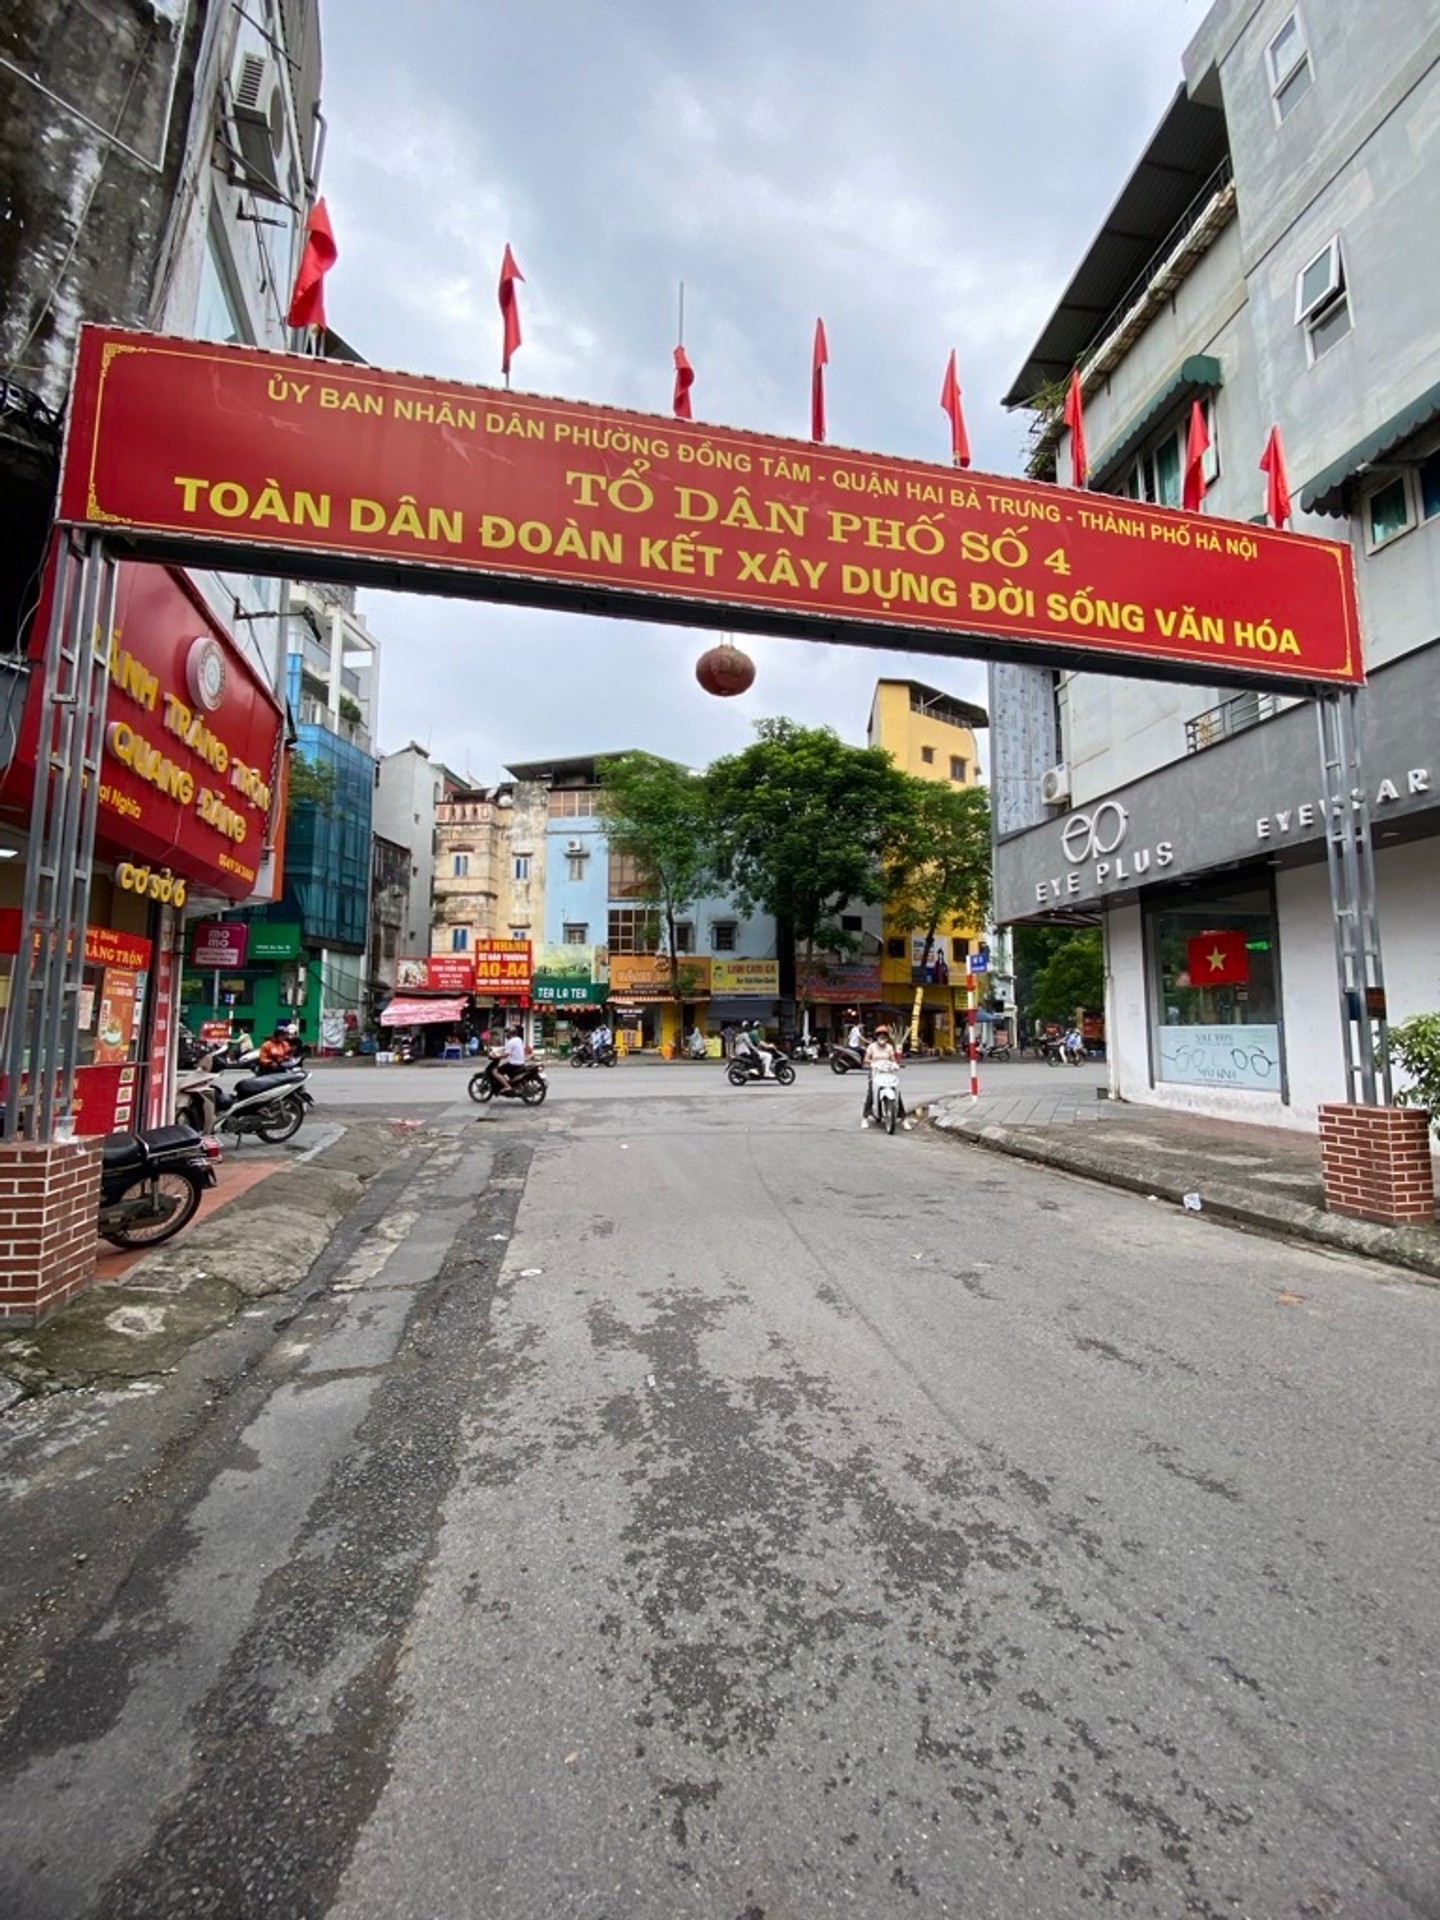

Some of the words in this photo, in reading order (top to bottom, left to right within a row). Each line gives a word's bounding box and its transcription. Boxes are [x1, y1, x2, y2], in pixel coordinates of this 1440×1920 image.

[268, 373, 310, 404] ỦY
[320, 388, 383, 416] BAN
[394, 400, 476, 431] NHÂN
[486, 412, 544, 440] DÂN
[554, 423, 670, 460] PHƯỜNG
[677, 440, 752, 474] ĐỒNG
[759, 456, 811, 483] TÂM
[832, 470, 899, 502] QUẬN
[906, 481, 945, 505] HAI
[950, 486, 981, 510] BÀ
[986, 496, 1061, 524] TRƯNG
[1079, 510, 1145, 541] THÀNH
[1150, 520, 1191, 548] PHỐ
[1196, 532, 1222, 555] HÀ
[1226, 537, 1258, 561] NỘI
[566, 458, 653, 513] TỔ
[674, 485, 809, 538] DÂN
[827, 511, 945, 557] PHỐ
[961, 526, 1029, 569] SỐ
[1043, 548, 1071, 576] 4
[174, 476, 331, 529] TOÀN
[350, 494, 463, 544] DÂN
[479, 515, 623, 566] ĐOÀN
[639, 530, 723, 577] KẾT
[737, 548, 828, 591] XÂY
[842, 564, 958, 610] DỰNG
[968, 577, 1034, 619] ĐỜI
[1046, 586, 1146, 635] SỐNG
[1154, 605, 1225, 646] VĂN
[1234, 617, 1302, 656] HÓA
[105, 721, 195, 806] QUANG
[1036, 872, 1081, 903] EYE
[1096, 842, 1174, 885] PLUS
[538, 988, 554, 998] TEA
[571, 988, 588, 998] TEA
